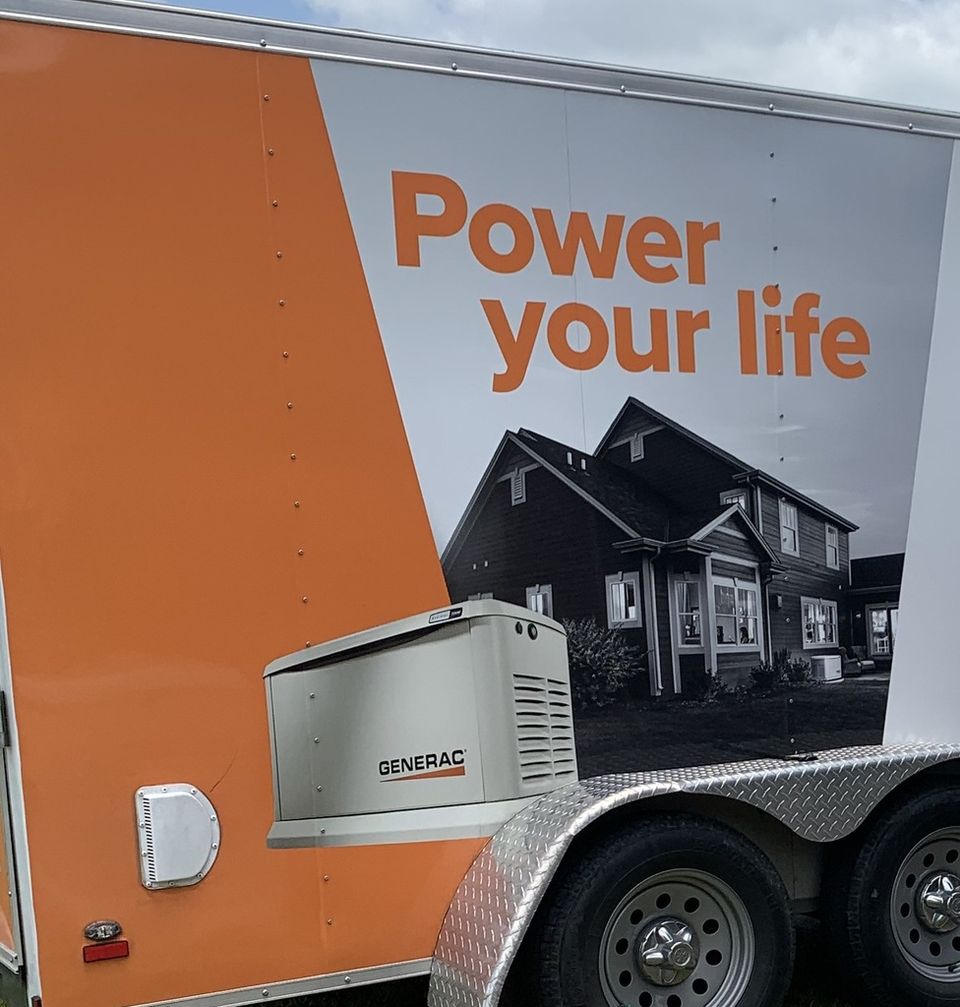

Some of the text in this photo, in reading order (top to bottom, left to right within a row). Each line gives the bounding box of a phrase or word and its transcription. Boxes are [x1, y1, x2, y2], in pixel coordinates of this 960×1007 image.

[393, 172, 719, 283] Power
[481, 286, 869, 392] your life
[378, 749, 465, 776] GENERAC
